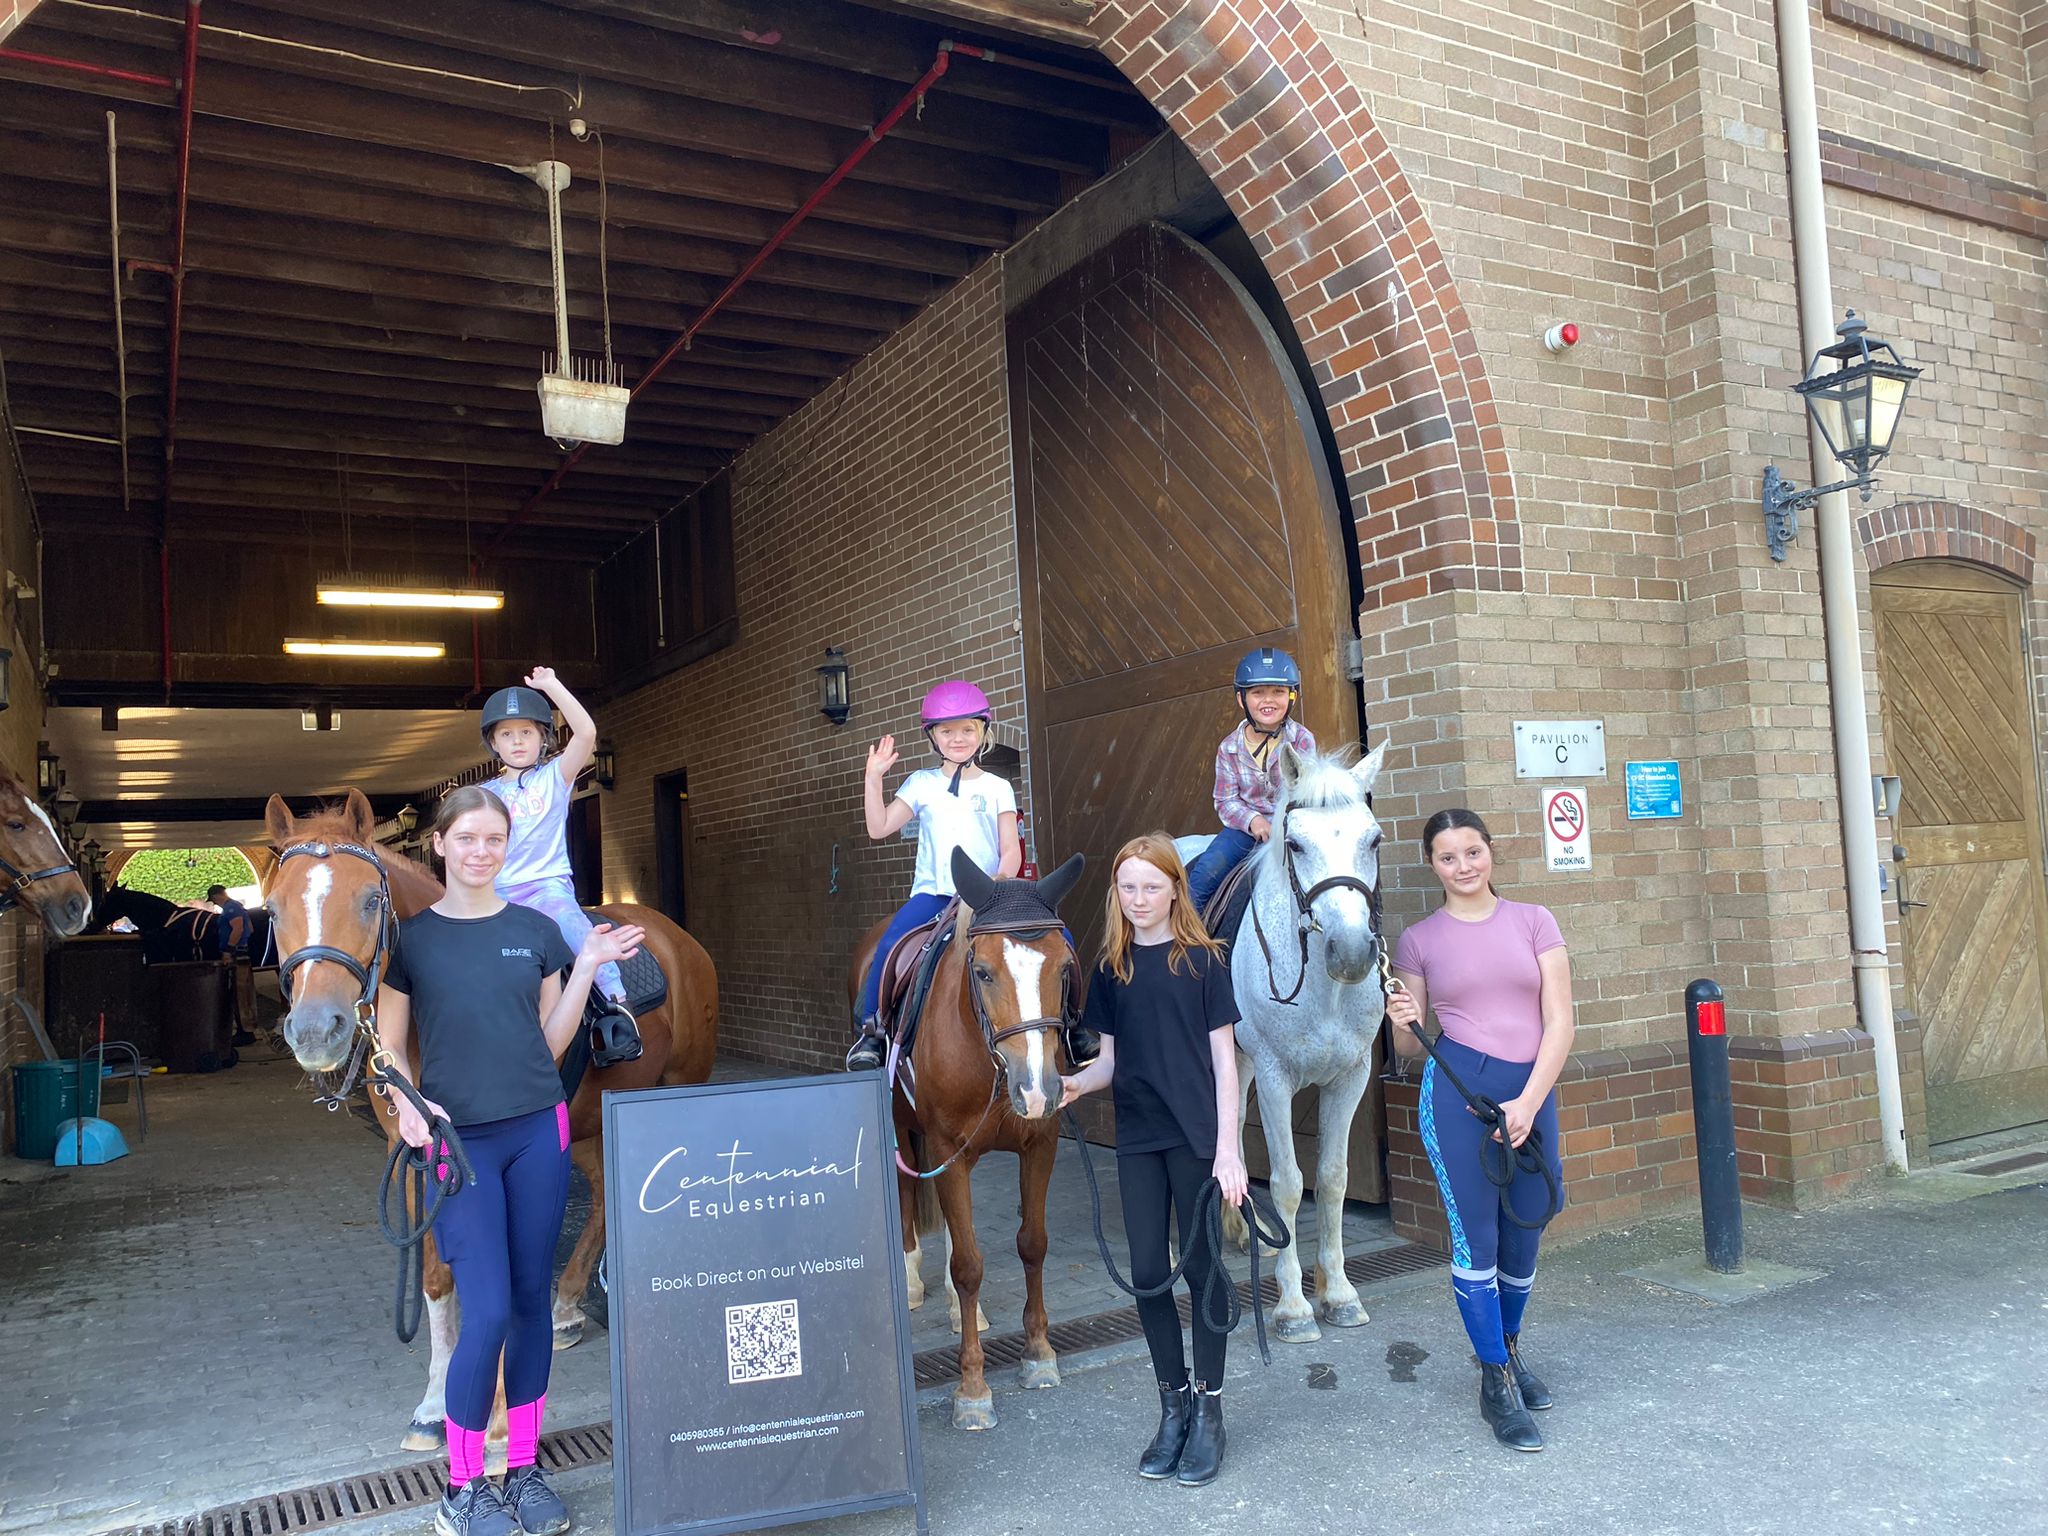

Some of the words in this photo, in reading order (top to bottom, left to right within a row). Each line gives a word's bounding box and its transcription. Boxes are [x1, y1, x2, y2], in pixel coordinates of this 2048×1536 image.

[1531, 734, 1589, 744] PAVILION
[1555, 745, 1568, 763] C
[1553, 856, 1586, 866] SMOKING
[1563, 846, 1574, 854] NO
[638, 1127, 863, 1214] Centennial
[689, 1190, 825, 1219] Equestrian
[651, 1274, 693, 1292] Book
[697, 1269, 743, 1287] Direct
[747, 1269, 766, 1281] on
[771, 1265, 796, 1279] our
[799, 1254, 865, 1275] Website!
[670, 1428, 724, 1443] 0405980355
[732, 1409, 865, 1435] info@centennialequestrian.com
[696, 1427, 839, 1453] www.centennialequestrian.com
